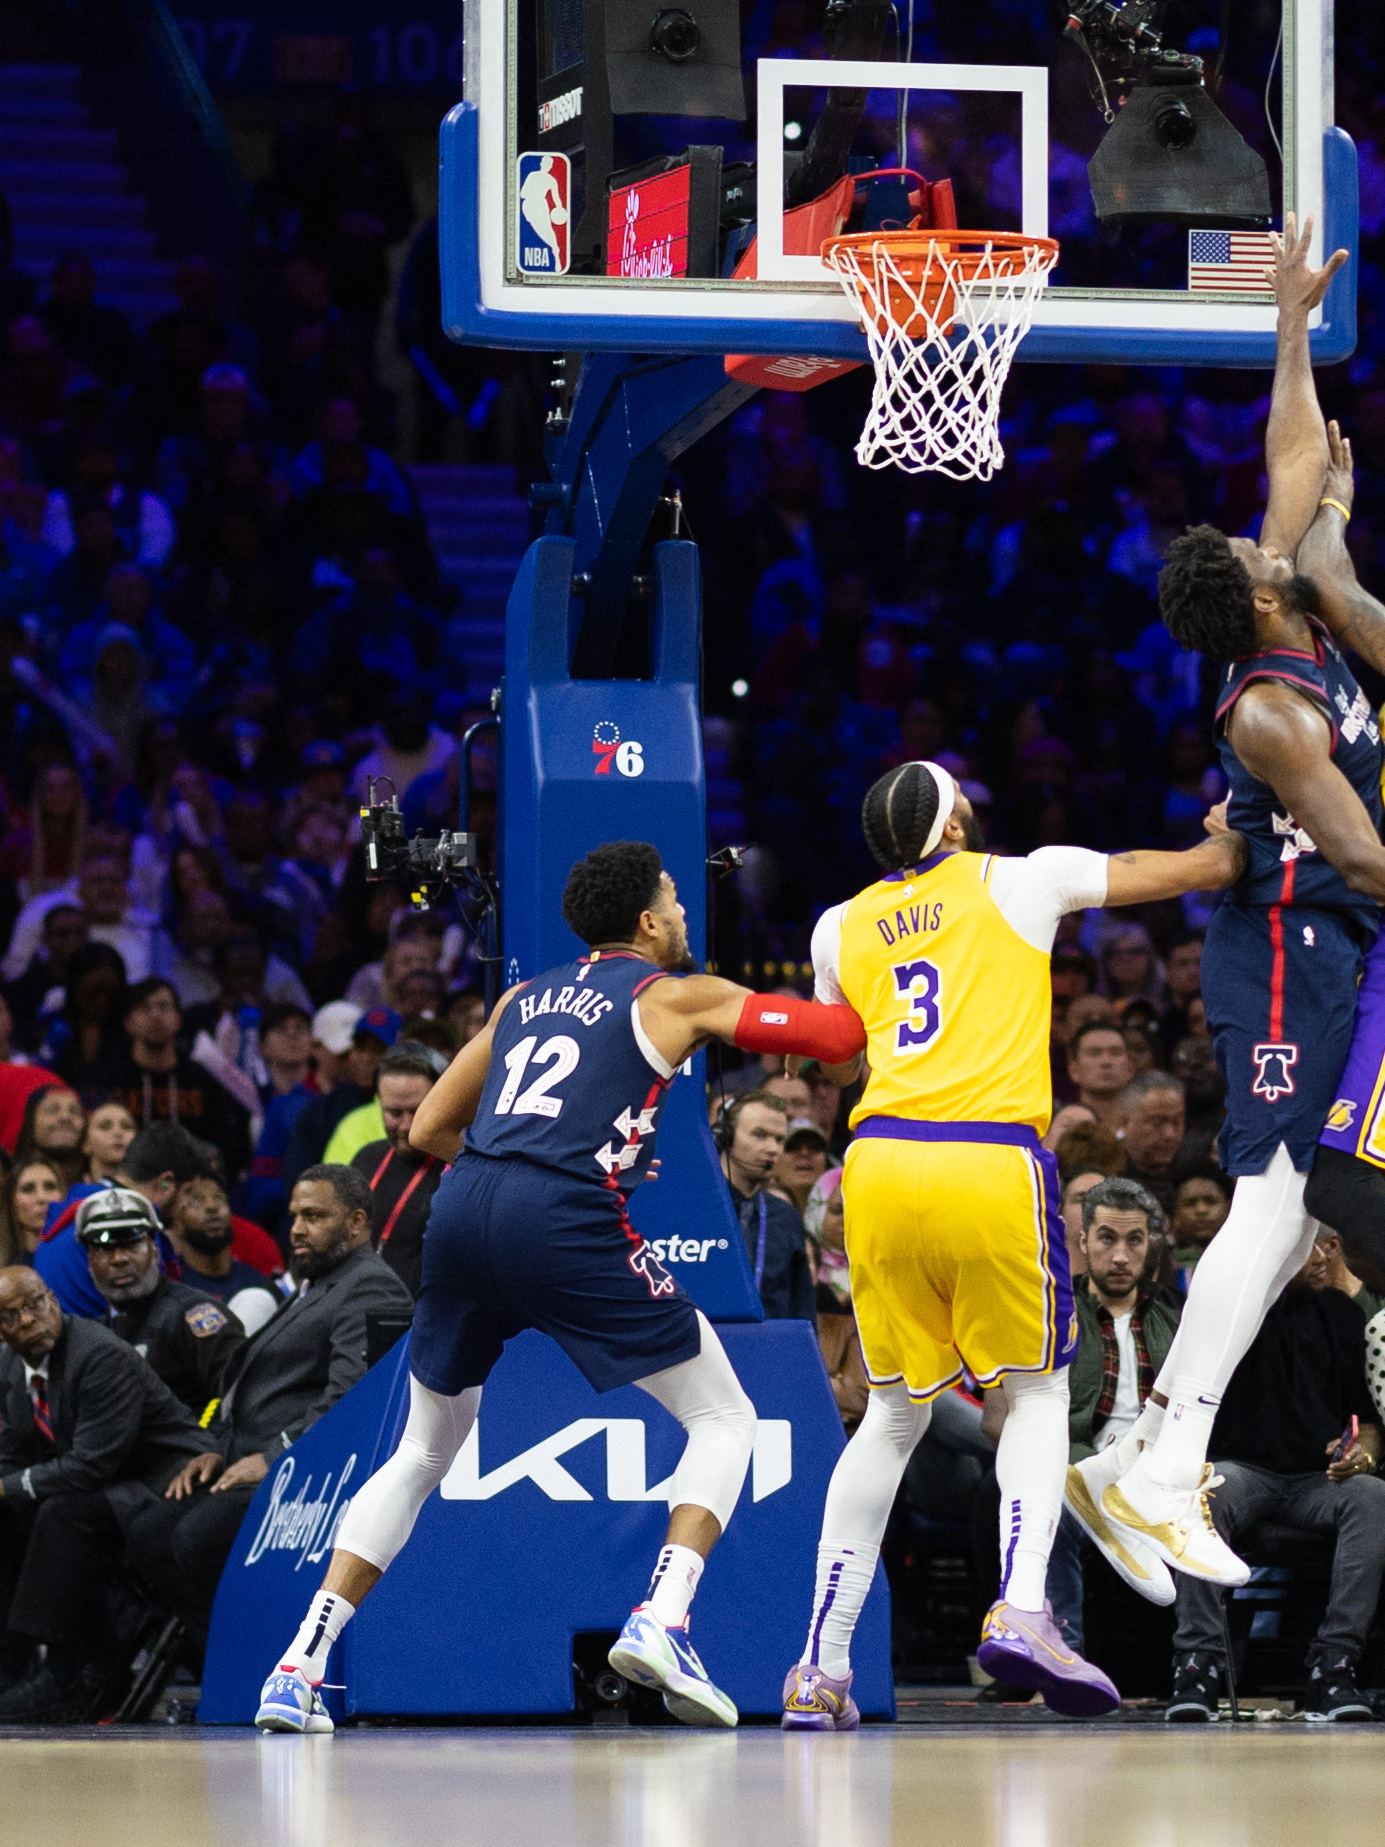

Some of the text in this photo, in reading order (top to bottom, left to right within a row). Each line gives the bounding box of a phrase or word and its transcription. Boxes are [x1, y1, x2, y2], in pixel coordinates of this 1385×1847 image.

[524, 247, 550, 267] NBA
[592, 739, 645, 778] 76
[876, 902, 943, 947] DAVIS
[518, 986, 614, 1026] HARRIS
[890, 957, 943, 1056] 3
[494, 1035, 581, 1118] 12
